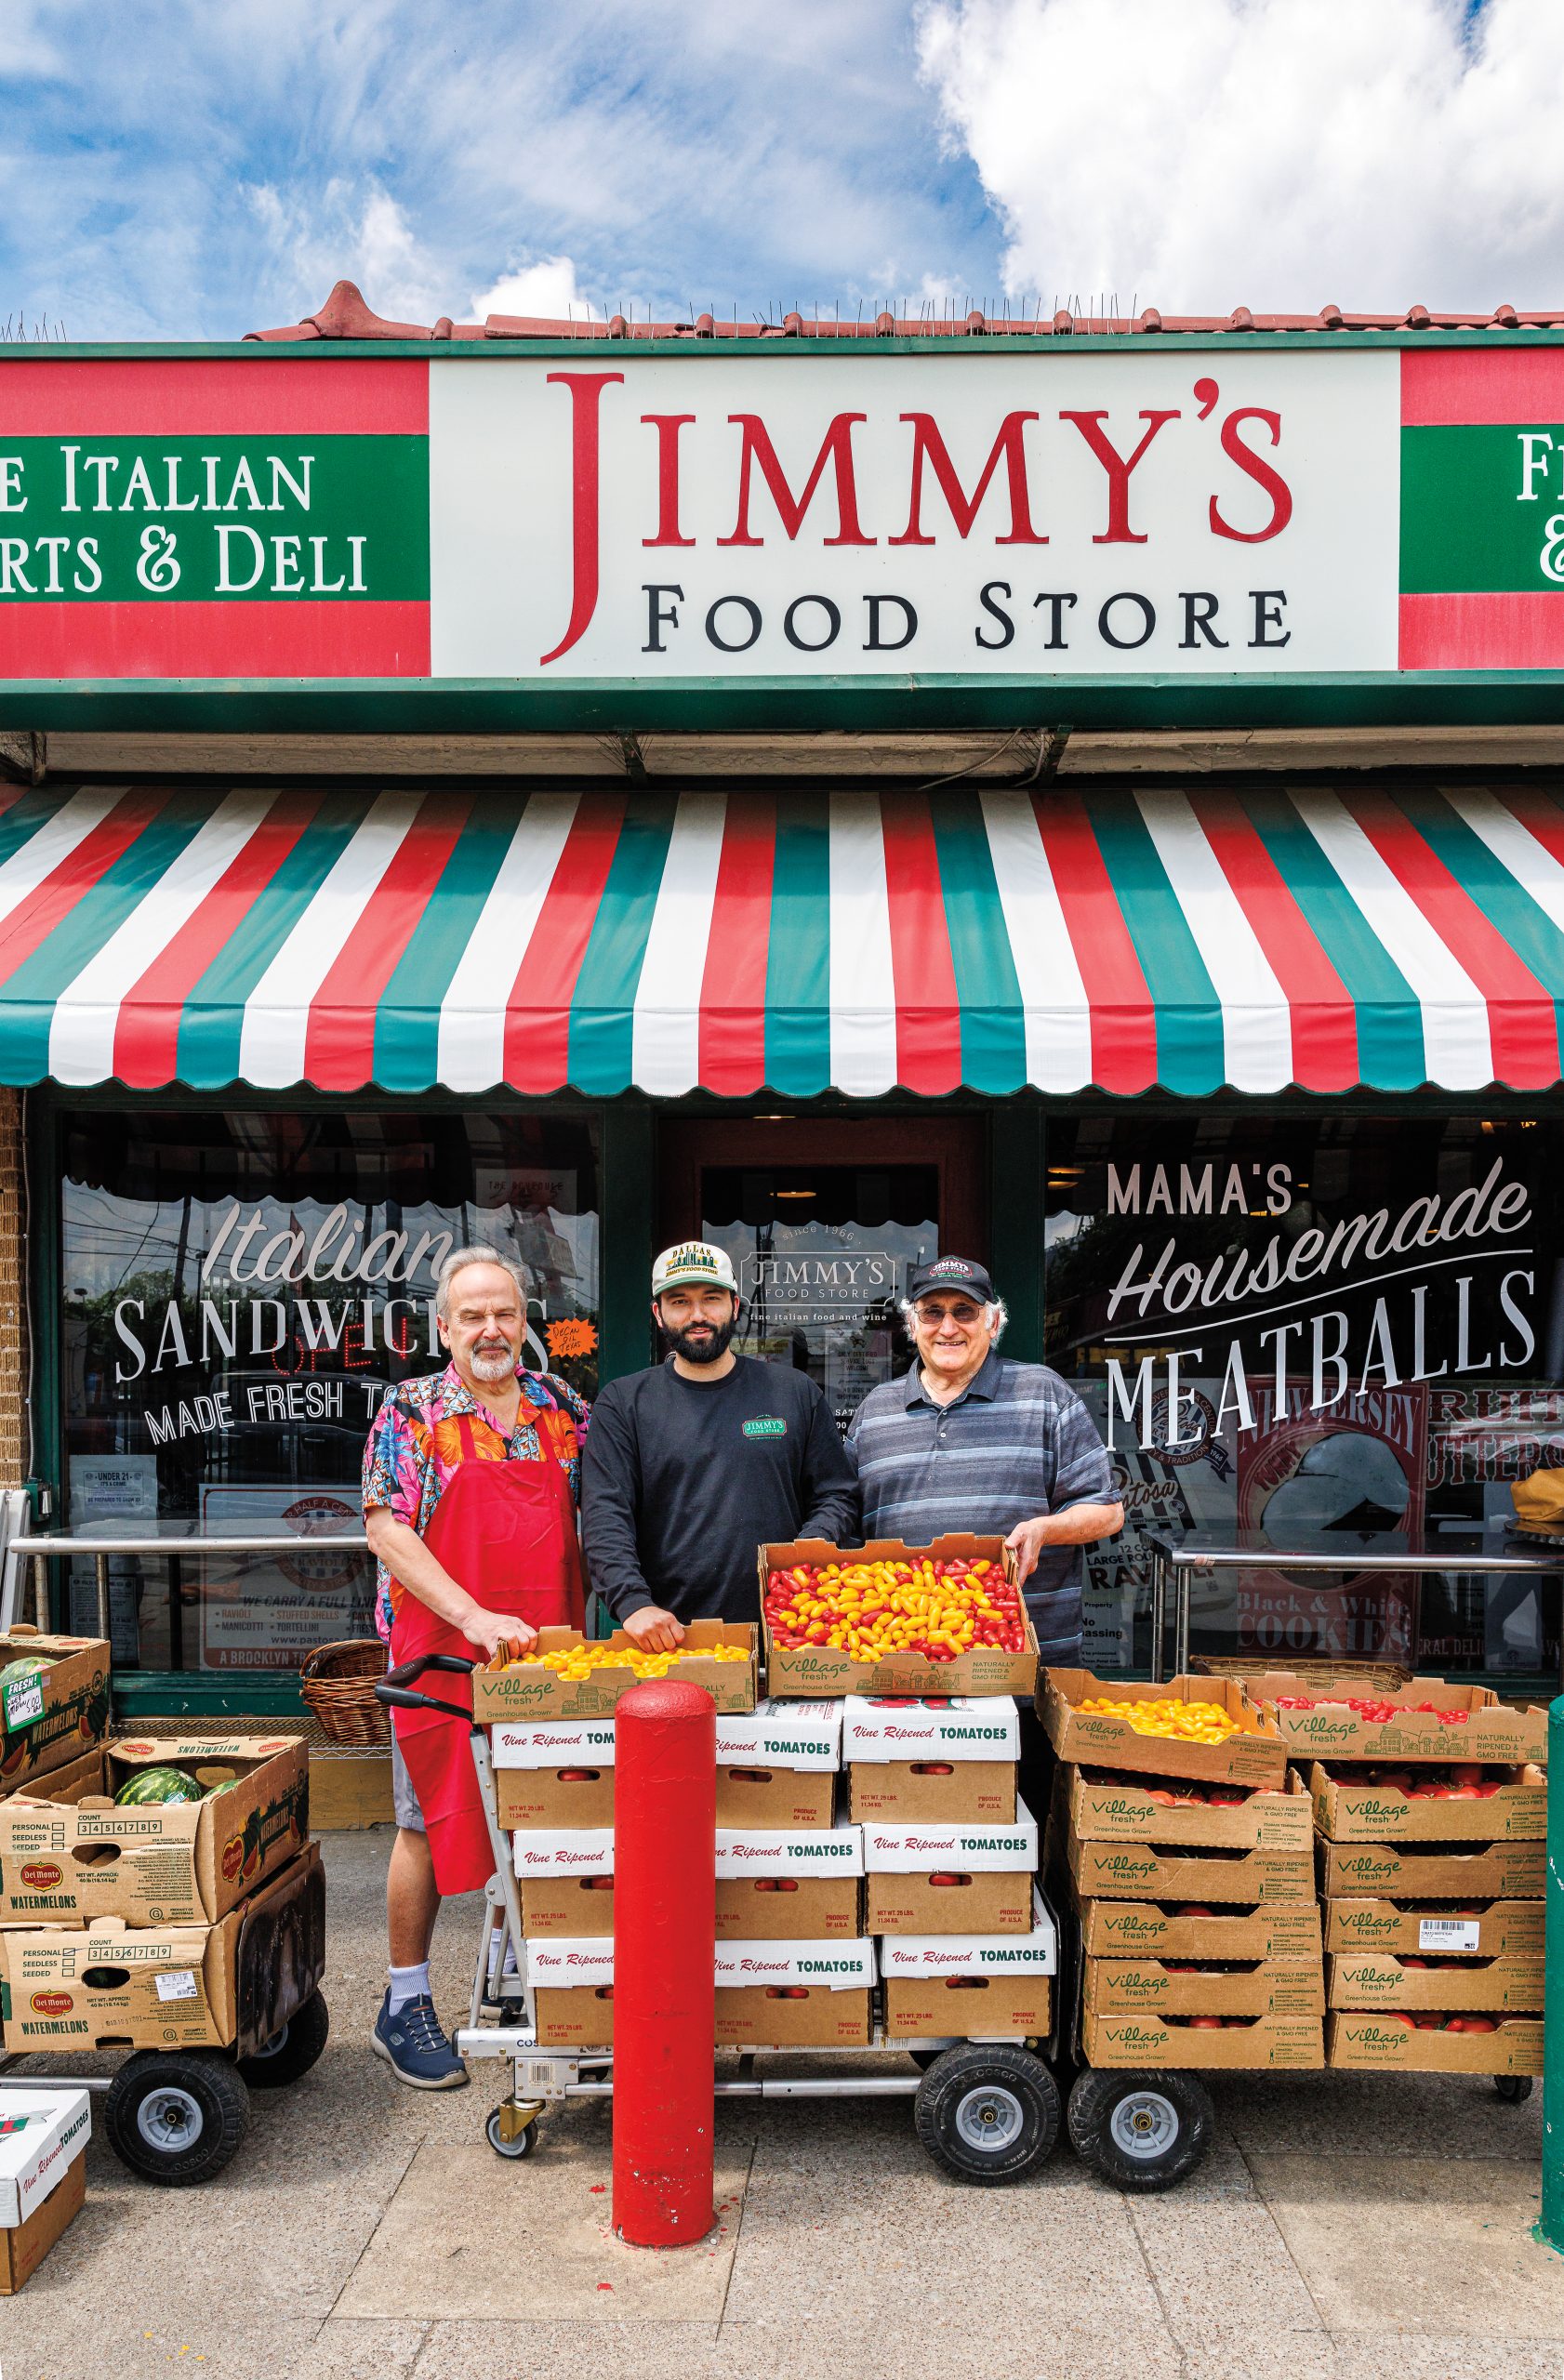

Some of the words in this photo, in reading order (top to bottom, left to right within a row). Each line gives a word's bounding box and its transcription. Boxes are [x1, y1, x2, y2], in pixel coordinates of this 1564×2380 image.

[540, 373, 1293, 667] JIMMY'S
[137, 525, 180, 592] &
[214, 525, 367, 591] DELI
[642, 585, 918, 653] FOOD
[974, 581, 1292, 651] STORE
[1107, 1164, 1292, 1215] MAMA'S
[782, 1225, 817, 1241] since
[824, 1224, 855, 1241] 1966
[1107, 1157, 1531, 1321] Housemade
[201, 1202, 454, 1283] Italian
[672, 1245, 711, 1259] DALLAS
[751, 1258, 884, 1285] JIMMY'S
[765, 1289, 810, 1298] FOOD
[818, 1289, 869, 1299] STORE
[749, 1313, 771, 1321] fine
[775, 1313, 809, 1321] italian
[813, 1313, 835, 1321] food
[839, 1313, 857, 1321] and
[861, 1313, 887, 1321] wine
[1104, 1270, 1535, 1452] MEATBALLS
[144, 1392, 235, 1446] MADE
[248, 1382, 343, 1423] FRESH
[747, 1421, 783, 1430] JIMMY'S
[121, 1473, 129, 1481] 21
[295, 1501, 319, 1515] HALF
[322, 1500, 329, 1509] A
[1119, 1545, 1132, 1554] 12
[1086, 1554, 1124, 1567] LARGE
[244, 1597, 262, 1606] WE
[266, 1596, 305, 1606] CARRY
[307, 1596, 315, 1606] A
[318, 1597, 349, 1608] FULL
[1237, 1593, 1302, 1612] Black
[1310, 1595, 1330, 1613] &
[1339, 1597, 1409, 1616] White
[277, 1610, 310, 1620] STUFFED
[311, 1610, 339, 1620] SHELLS
[222, 1622, 263, 1631] MANICOTTI
[277, 1622, 319, 1632] TORTELLINI
[1237, 1613, 1410, 1653] COOKIES
[219, 1653, 227, 1664] A
[231, 1652, 288, 1665] BROOKLYN
[779, 1658, 851, 1680] Village
[802, 1672, 829, 1681] fresh
[8, 1674, 38, 1695] FRESH!
[482, 1678, 555, 1702] Village
[505, 1695, 533, 1705] fresh
[33, 1706, 78, 1745] WATERMELONS
[853, 1726, 879, 1739] Vine
[883, 1726, 934, 1740] Ripened
[940, 1727, 1007, 1740] TOMATOES
[1076, 1722, 1125, 1739] Village
[1289, 1717, 1359, 1745] Village
[502, 1732, 528, 1747] Vine
[531, 1732, 583, 1748] Ripened
[1309, 1732, 1337, 1743] fresh
[1477, 1734, 1525, 1742] NATURALLY
[177, 1745, 240, 1754] WATERMELONS
[763, 1740, 830, 1755] TOMATOES
[1092, 1800, 1157, 1822] Village
[1345, 1801, 1410, 1821] Village
[732, 1844, 782, 1860] Ripened
[788, 1844, 853, 1857] TOMATOES
[874, 1837, 901, 1850] Vine
[904, 1837, 955, 1852] Ripened
[961, 1838, 1027, 1851] TOMATOES
[524, 1851, 550, 1864] Vine
[555, 1850, 605, 1865] Ripened
[24, 1871, 36, 1879] Del
[37, 1871, 60, 1879] Monte
[1094, 1857, 1159, 1878] Village
[1338, 1858, 1402, 1878] Village
[11, 1895, 77, 1910] WATERMELONS
[1105, 1917, 1169, 1938] Village
[1338, 1913, 1402, 1934] Village
[537, 1954, 562, 1967] Vine
[566, 1953, 615, 1967] Ripened
[892, 1950, 919, 1964] Vine
[921, 1950, 973, 1965] Ripened
[980, 1950, 1046, 1963] TOMATOES
[740, 1958, 789, 1973] Ripened
[796, 1960, 863, 1973] TOMATOES
[1107, 1973, 1170, 1994] Village
[1343, 1968, 1404, 1989] Village
[1125, 1988, 1150, 1997] fresh
[1360, 1982, 1385, 1991] fresh
[47, 1998, 71, 2006] Monte
[21, 2020, 88, 2035] WATERMELONS
[1106, 2027, 1169, 2047] Village
[1346, 2028, 1409, 2049] Village
[1124, 2041, 1149, 2050] fresh
[1364, 2043, 1389, 2051] fresh
[23, 2172, 38, 2194] Vine
[60, 2108, 89, 2151] TOMATOES
